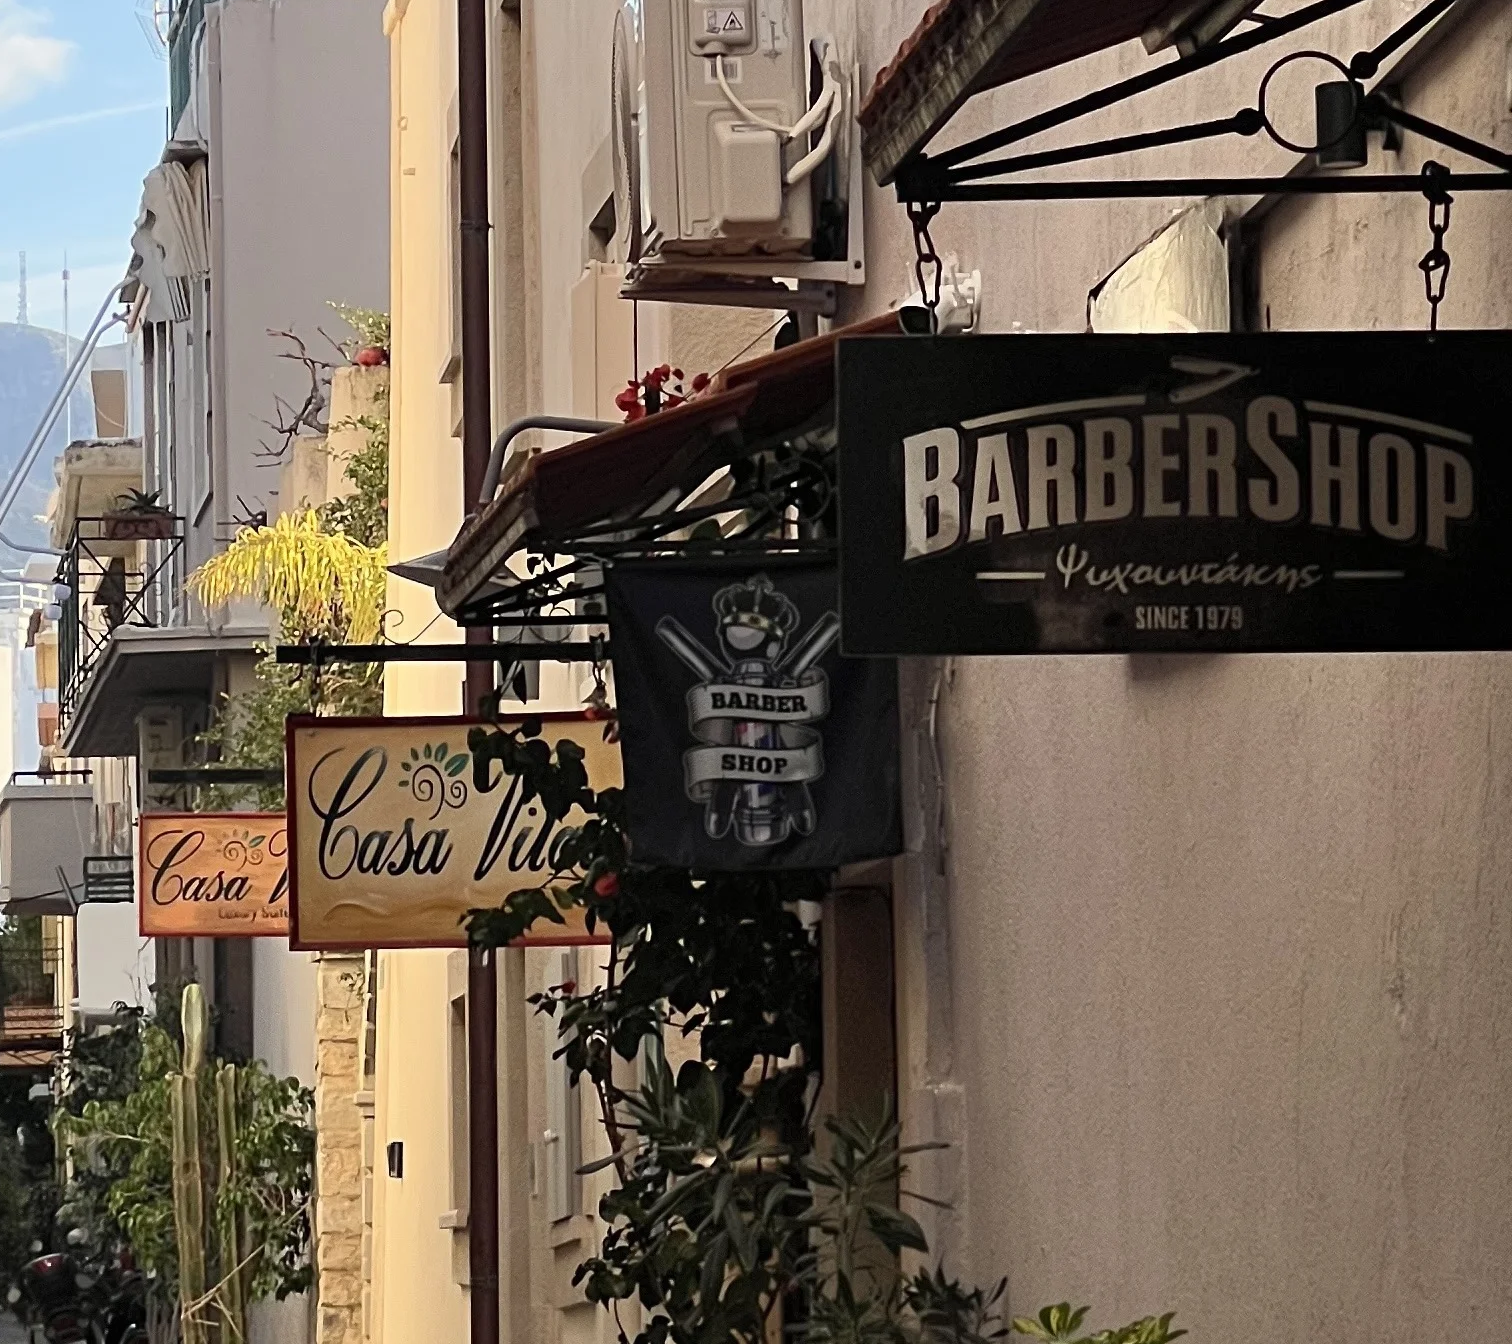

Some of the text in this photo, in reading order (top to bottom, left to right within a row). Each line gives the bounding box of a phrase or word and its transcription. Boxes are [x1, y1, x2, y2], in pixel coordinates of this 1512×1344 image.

[1055, 543, 1324, 593] Ψυχουντάκης
[1136, 605, 1243, 630] SINCE 1979
[711, 691, 808, 713] BARBER
[721, 753, 789, 775] SHOP
[308, 746, 454, 881] Casa
[146, 829, 252, 906] Casa
